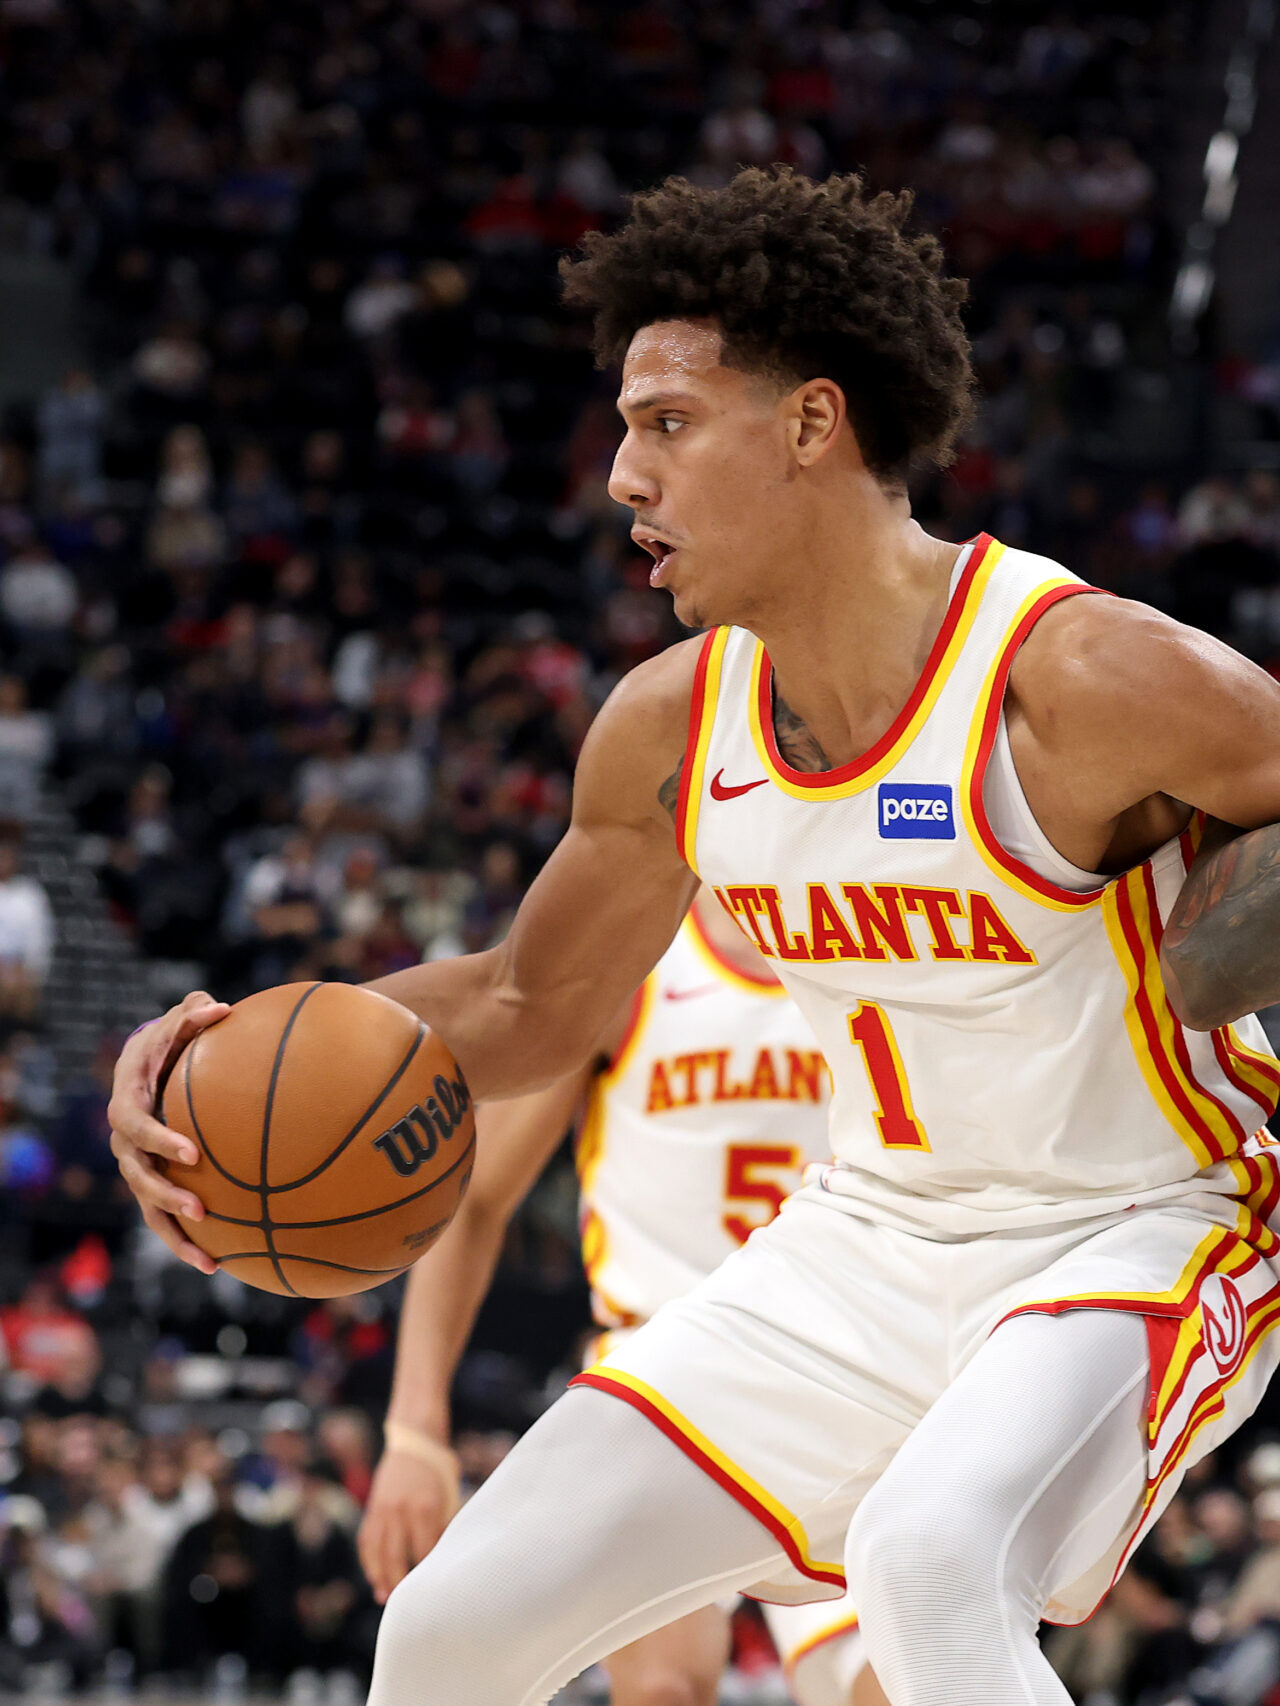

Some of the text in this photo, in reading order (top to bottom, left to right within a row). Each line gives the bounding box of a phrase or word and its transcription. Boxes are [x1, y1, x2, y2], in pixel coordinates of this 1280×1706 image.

[882, 797, 949, 826] paze
[644, 1046, 834, 1118] ATLAN
[846, 998, 933, 1153] 1
[721, 1141, 803, 1250] 5
